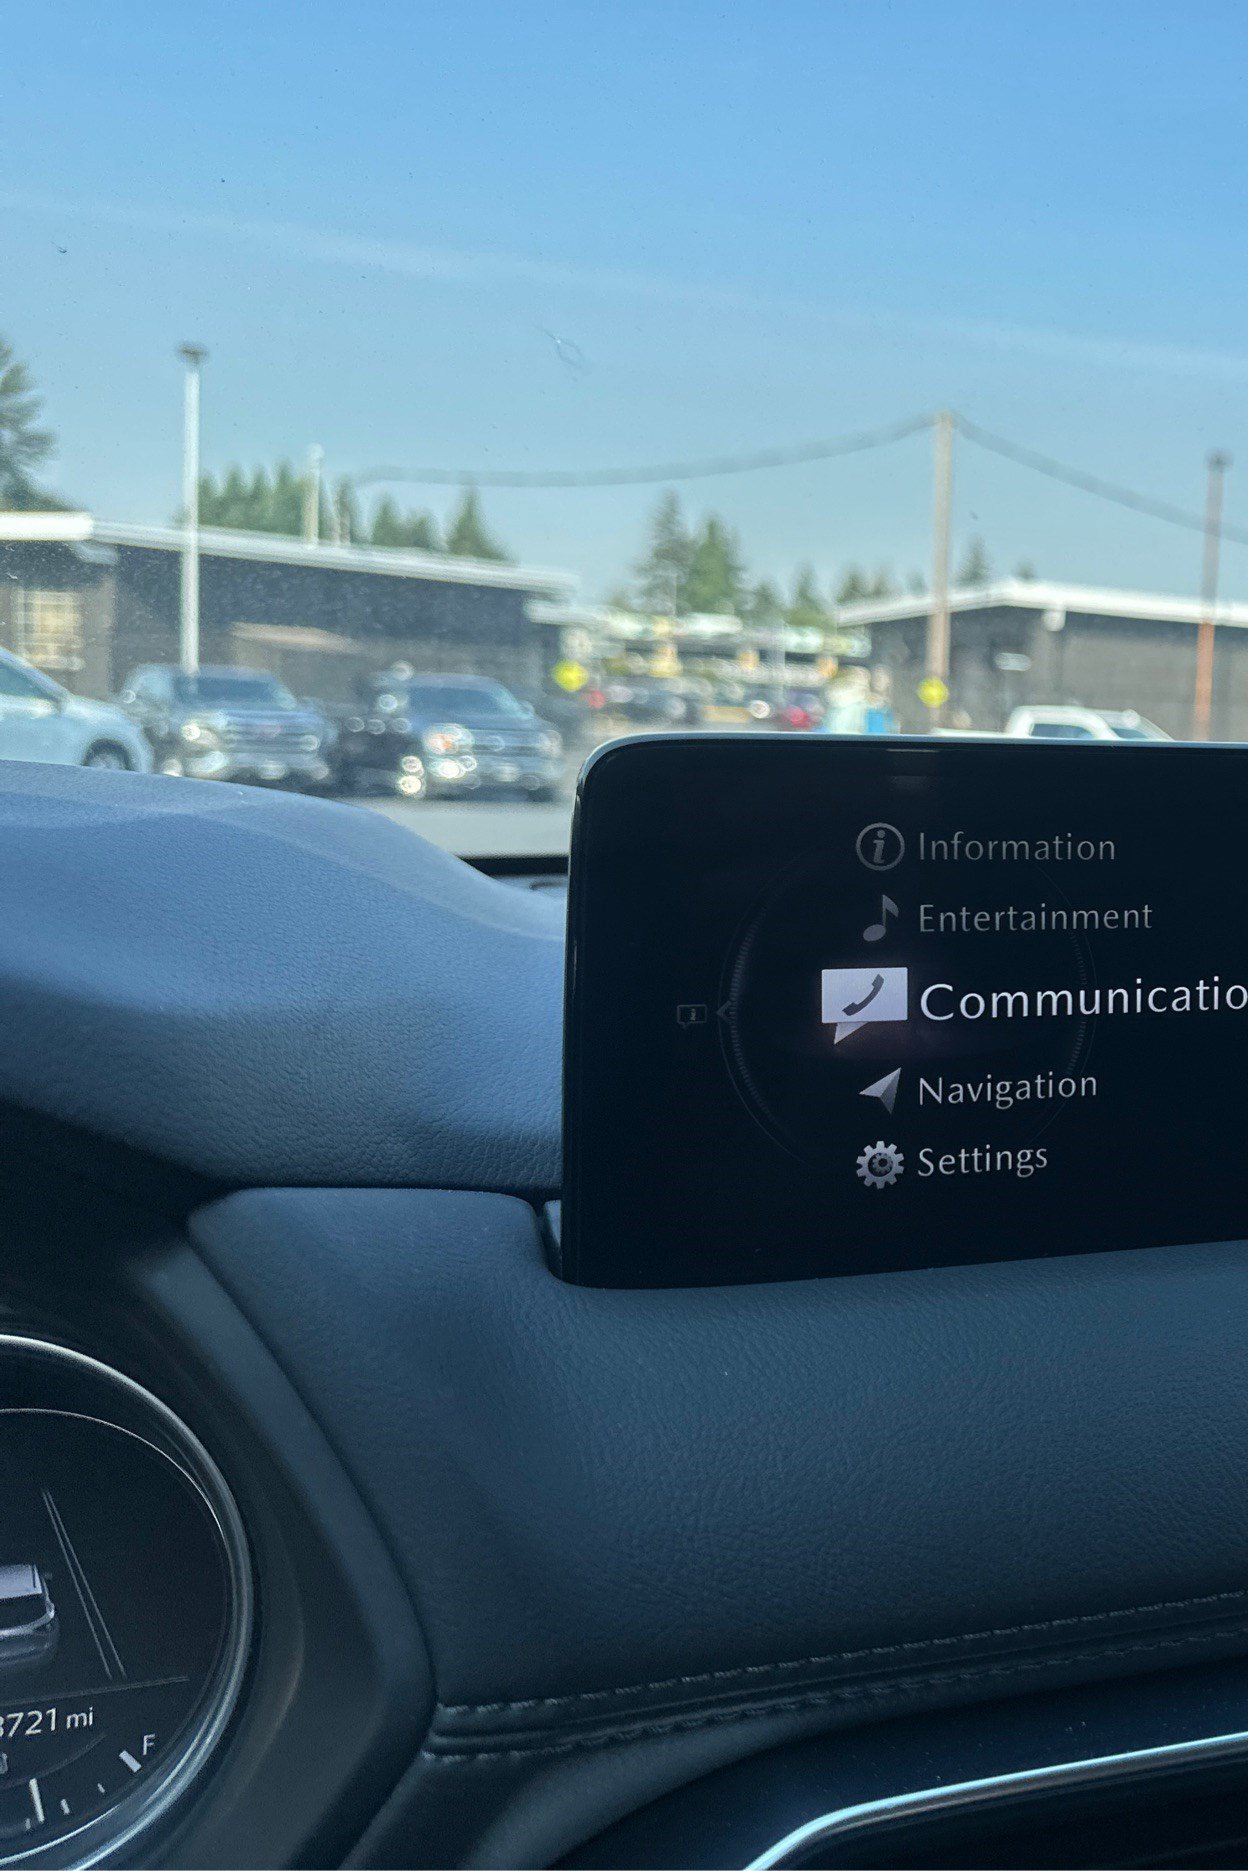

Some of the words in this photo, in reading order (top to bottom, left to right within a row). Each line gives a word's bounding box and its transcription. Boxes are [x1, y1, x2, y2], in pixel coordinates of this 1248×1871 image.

[918, 830, 1116, 863] Information
[918, 902, 1153, 932] Entertainment
[918, 1069, 1097, 1110] Navigation
[917, 1143, 1048, 1179] Settings
[0, 1707, 57, 1738] 721
[66, 1706, 94, 1730] mi
[142, 1733, 156, 1756] F
